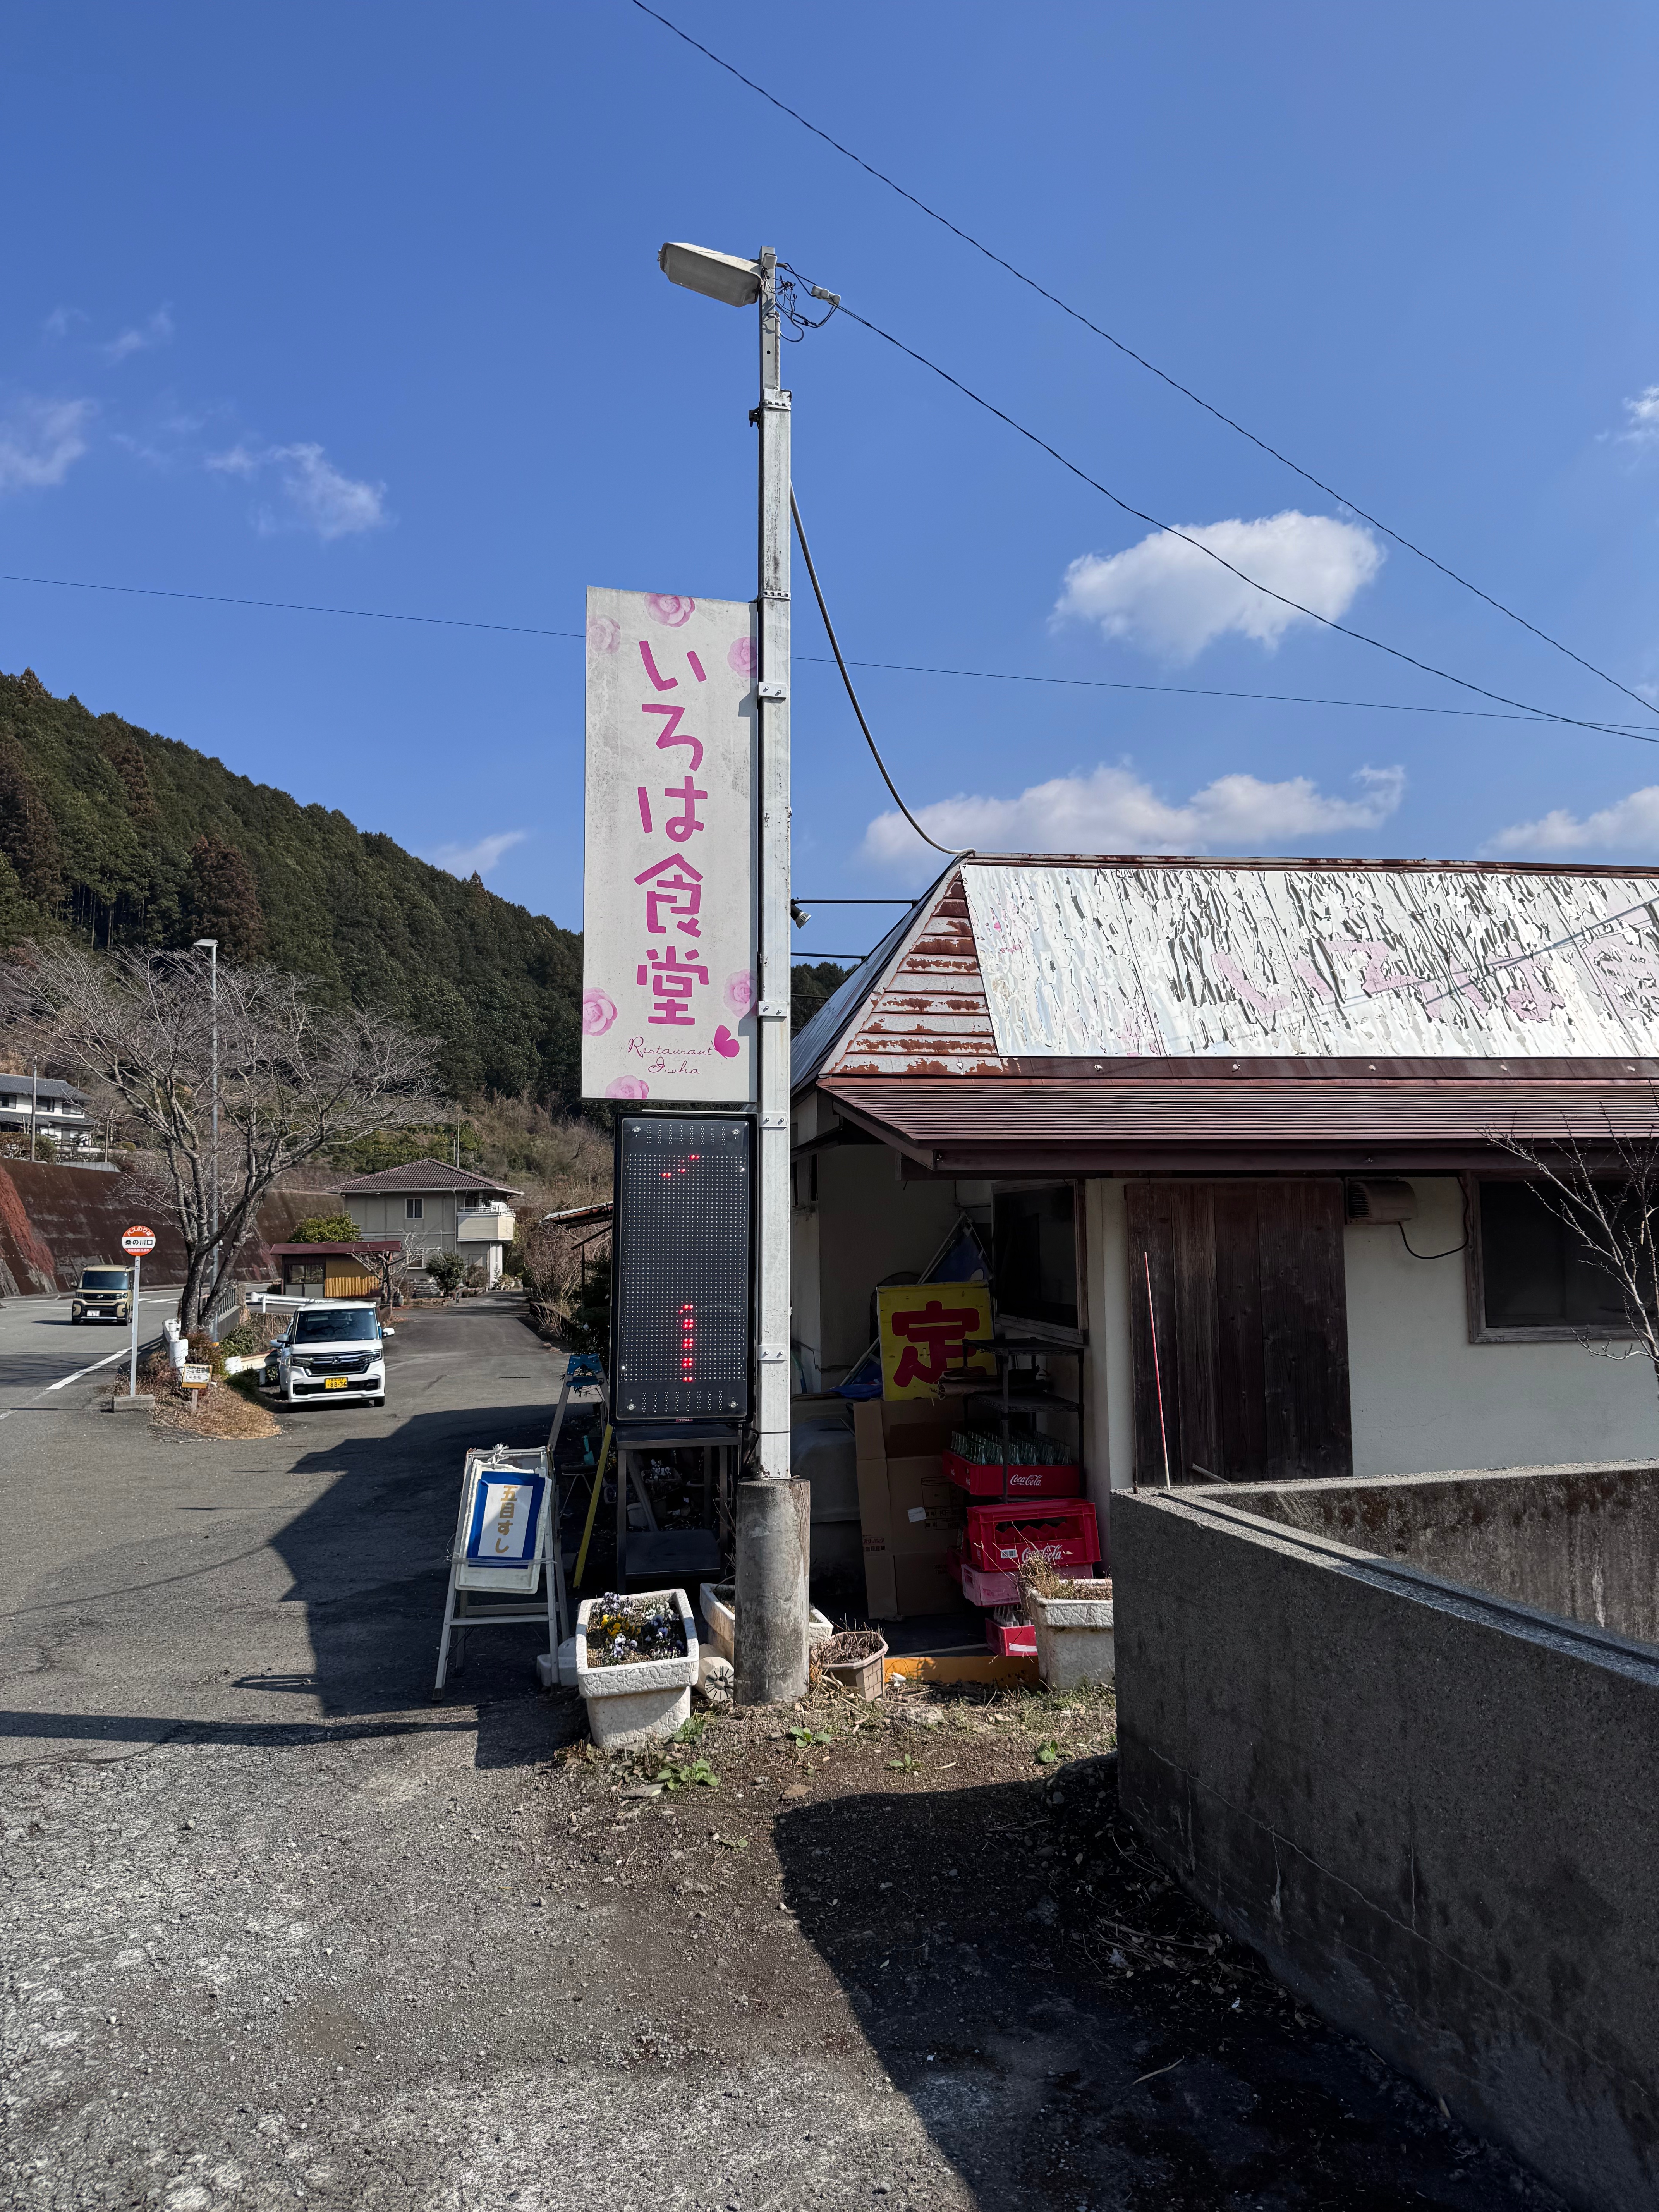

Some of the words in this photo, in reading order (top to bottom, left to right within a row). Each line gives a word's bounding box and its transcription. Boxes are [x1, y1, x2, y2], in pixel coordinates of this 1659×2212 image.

[634, 640, 710, 1025] いろは食堂
[628, 1036, 713, 1058] Restaurant
[648, 1056, 701, 1074] Iroha
[891, 1300, 987, 1388] 定
[495, 1485, 518, 1553] 五目すし
